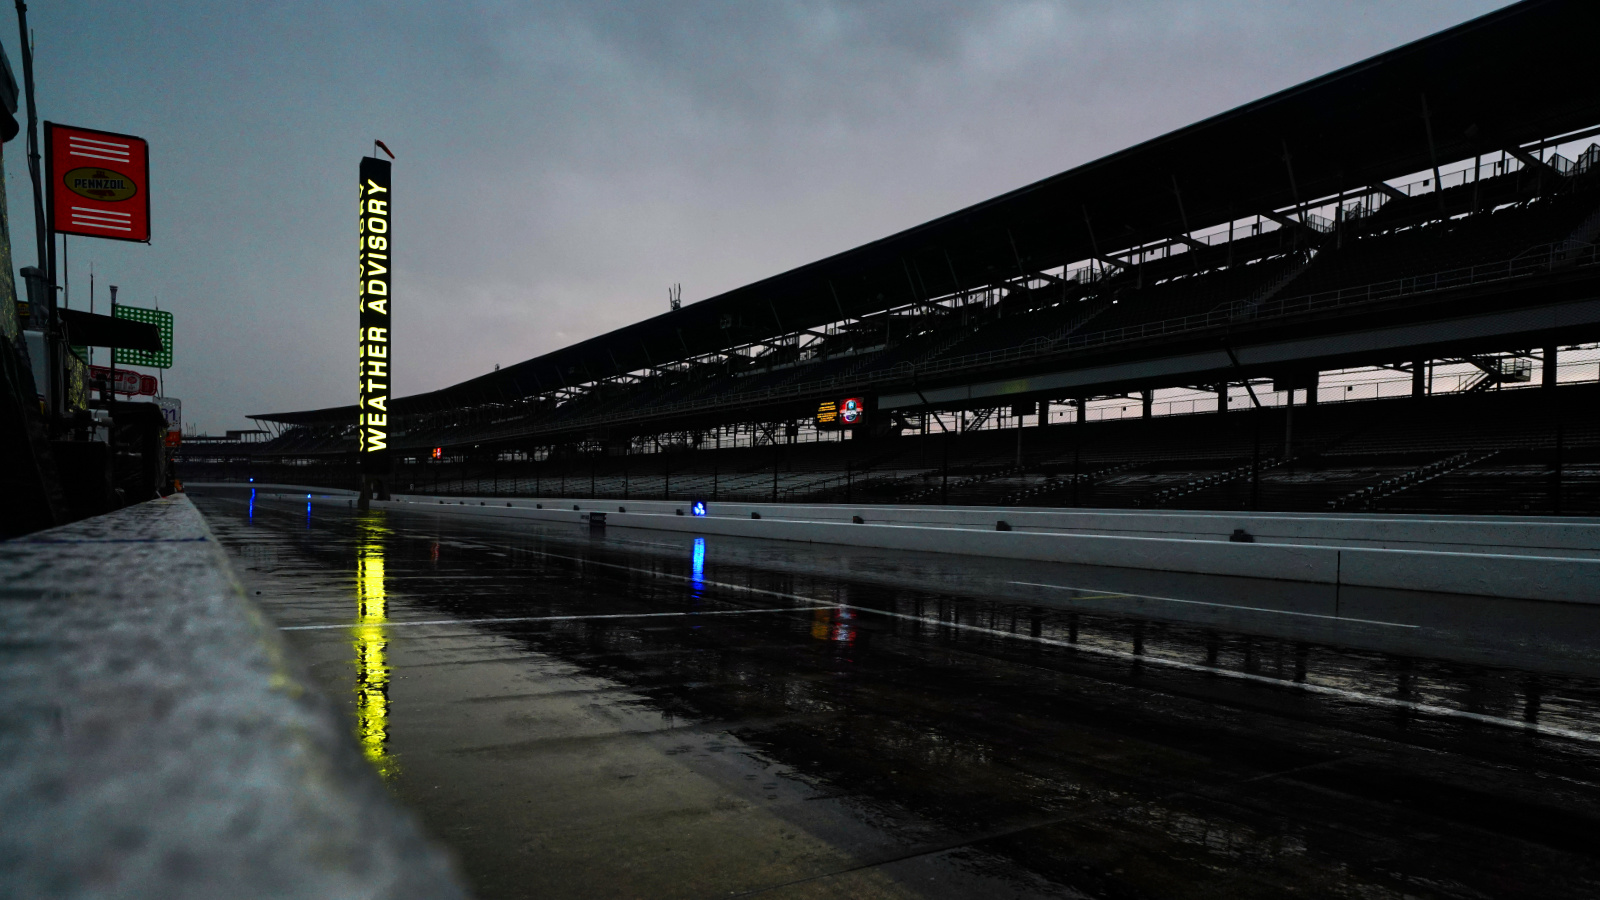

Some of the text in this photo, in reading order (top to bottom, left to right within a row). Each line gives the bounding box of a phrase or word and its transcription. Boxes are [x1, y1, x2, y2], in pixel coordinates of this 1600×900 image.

[74, 178, 126, 189] PENNZOIL
[367, 178, 388, 453] WEATHER ADVISORY
